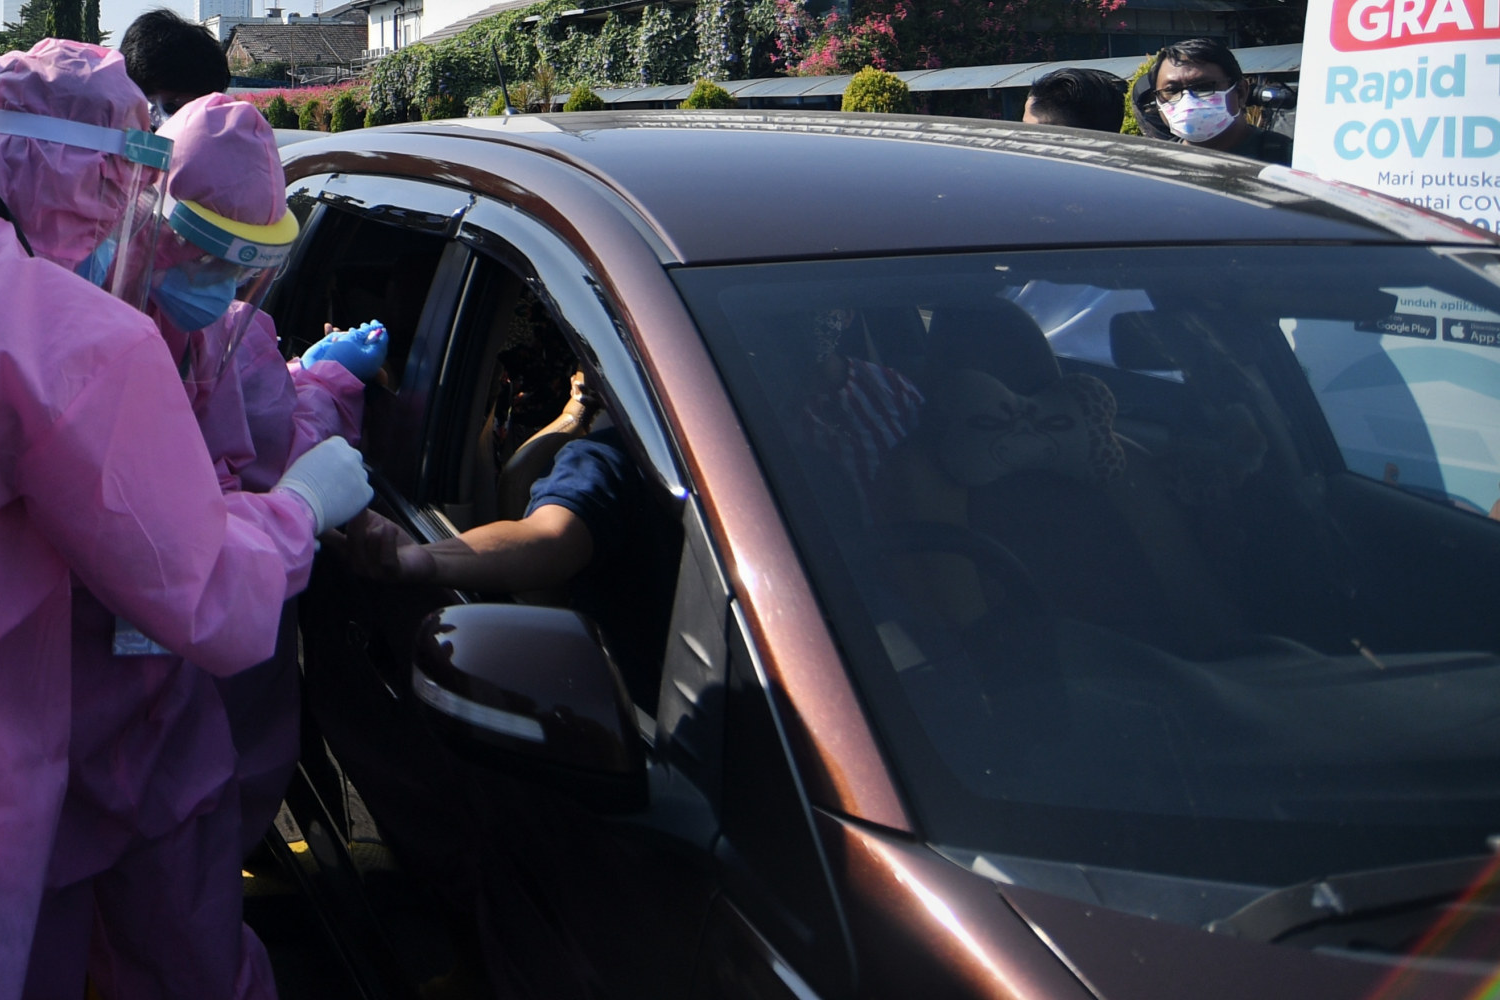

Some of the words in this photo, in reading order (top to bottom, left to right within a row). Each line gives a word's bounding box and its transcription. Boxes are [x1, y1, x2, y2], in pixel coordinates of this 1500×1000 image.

[1325, 53, 1467, 110] Rapid
[1333, 115, 1500, 161] COVID
[1378, 171, 1414, 185] Mari
[1400, 298, 1437, 310] unduh
[1376, 321, 1410, 334] Google
[1411, 322, 1431, 336] Play
